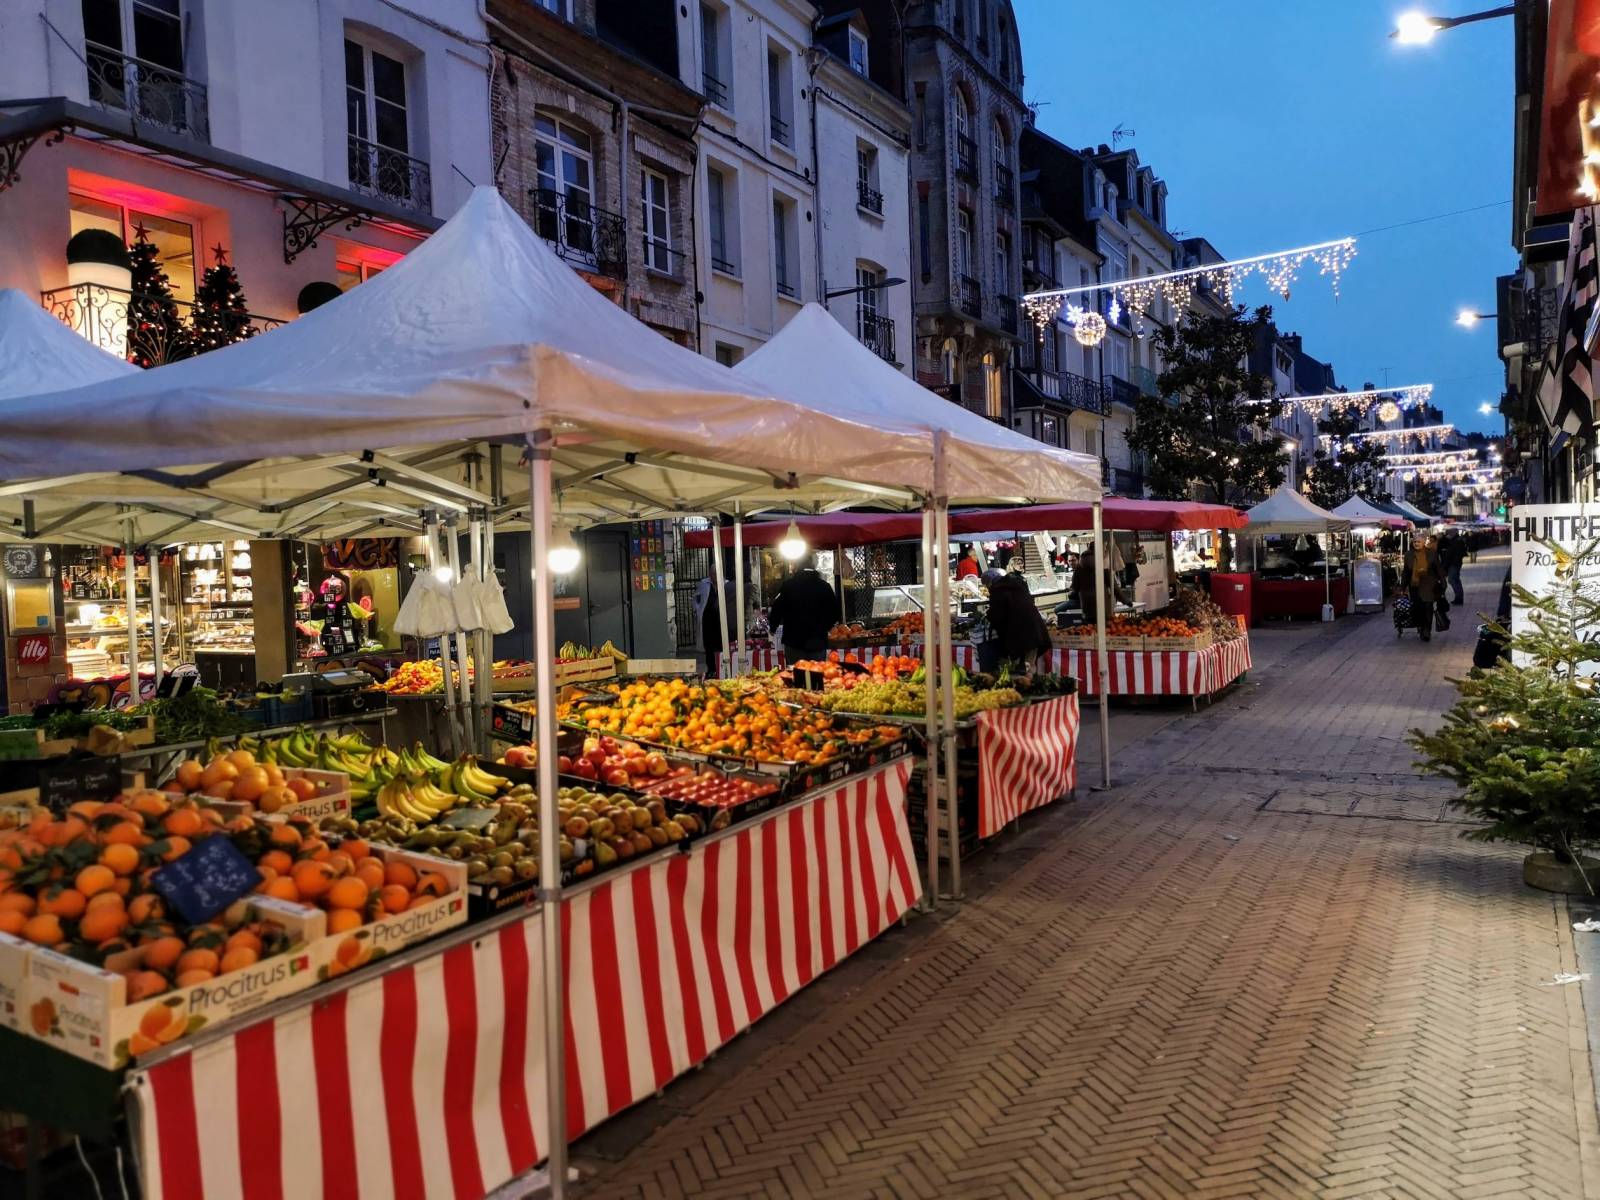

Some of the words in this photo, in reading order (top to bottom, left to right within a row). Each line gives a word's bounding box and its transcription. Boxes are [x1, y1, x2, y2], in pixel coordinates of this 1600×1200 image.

[22, 640, 48, 663] illy
[373, 904, 446, 945] Procitrus
[189, 963, 286, 1013] Procitrus
